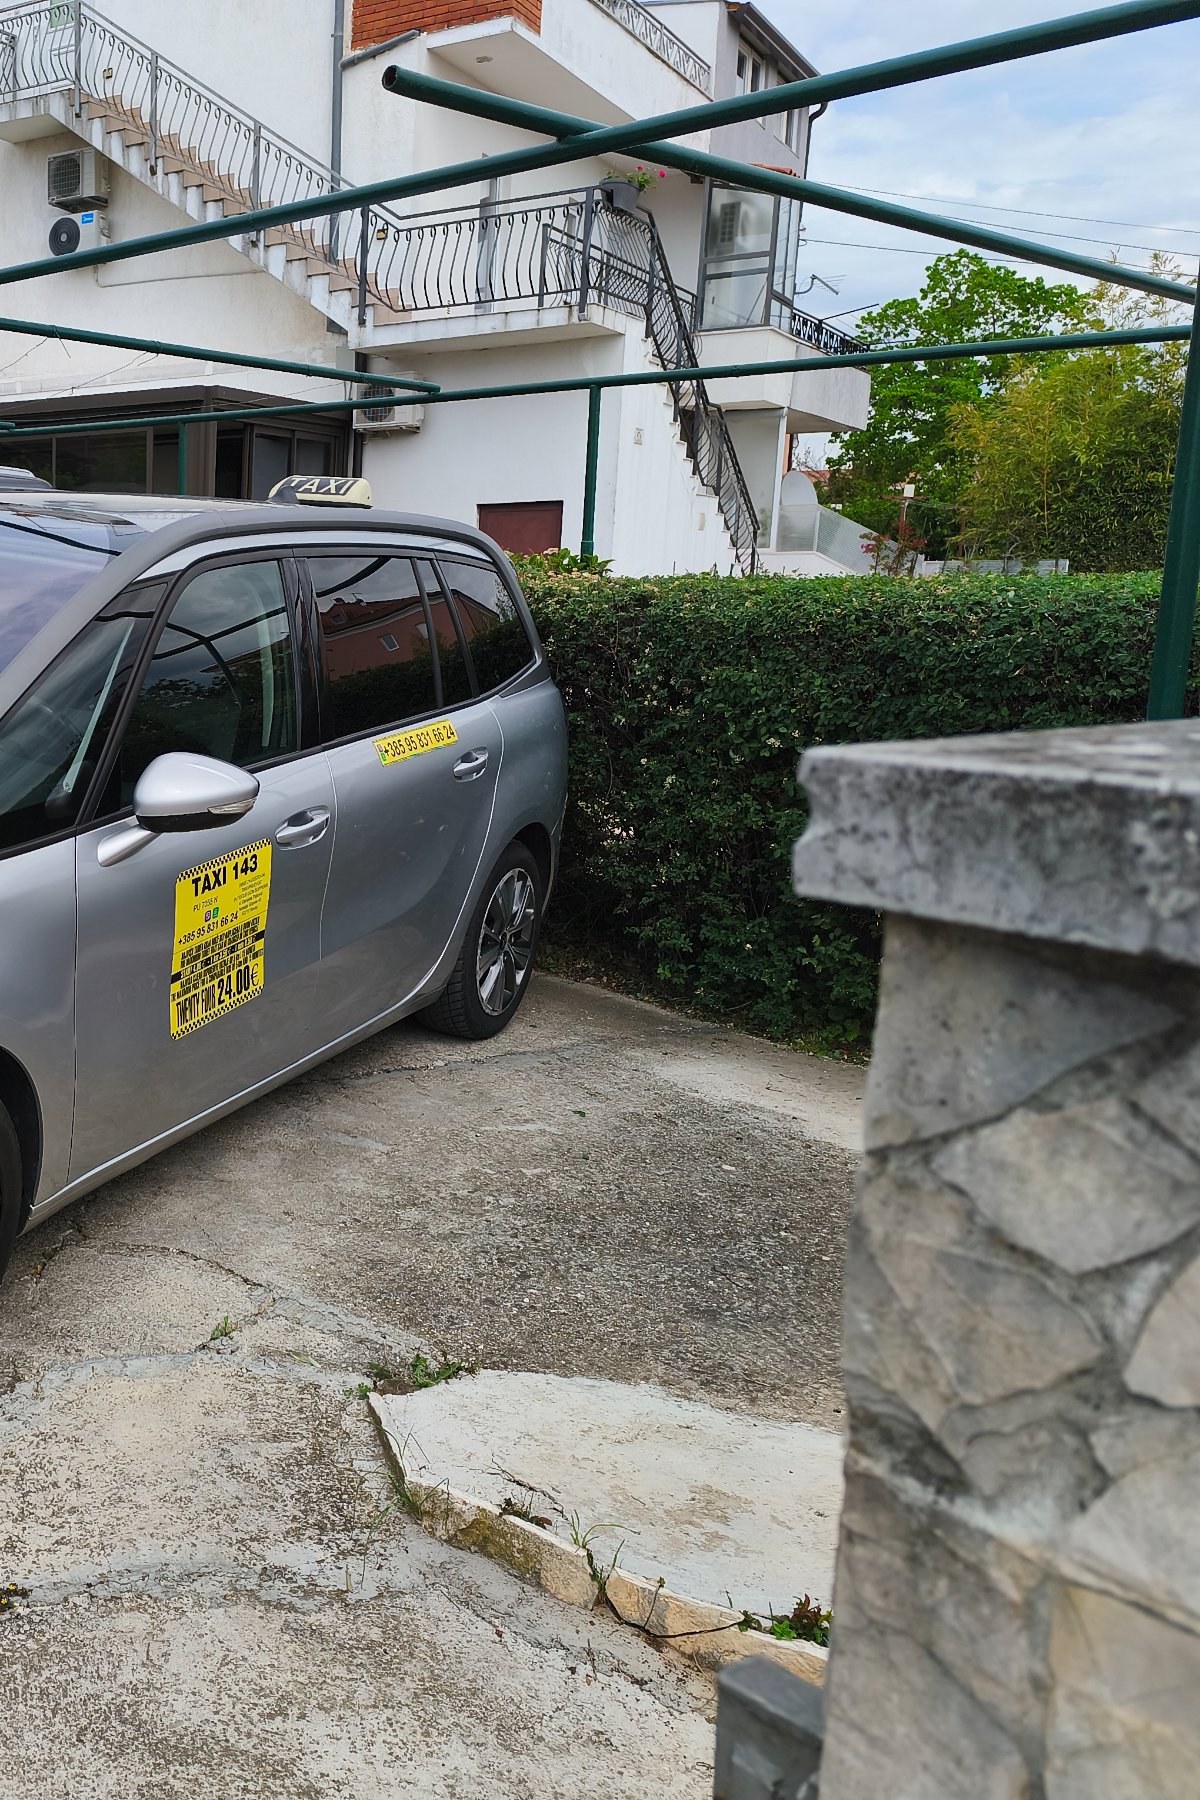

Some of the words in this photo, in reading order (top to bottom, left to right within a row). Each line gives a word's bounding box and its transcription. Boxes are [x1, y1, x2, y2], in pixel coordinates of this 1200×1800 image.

[290, 477, 355, 494] TAXI
[384, 738, 406, 757] +385
[404, 735, 418, 751] 95
[416, 730, 434, 748] 831
[432, 727, 445, 743] 66
[443, 724, 456, 740] 24
[191, 866, 227, 897] TAXI
[232, 853, 258, 880] 143
[178, 930, 196, 945] +385
[196, 926, 206, 939] 95
[206, 919, 219, 934] 831
[220, 915, 229, 928] 66
[230, 910, 239, 923] 24
[217, 963, 260, 1006] 24.00€
